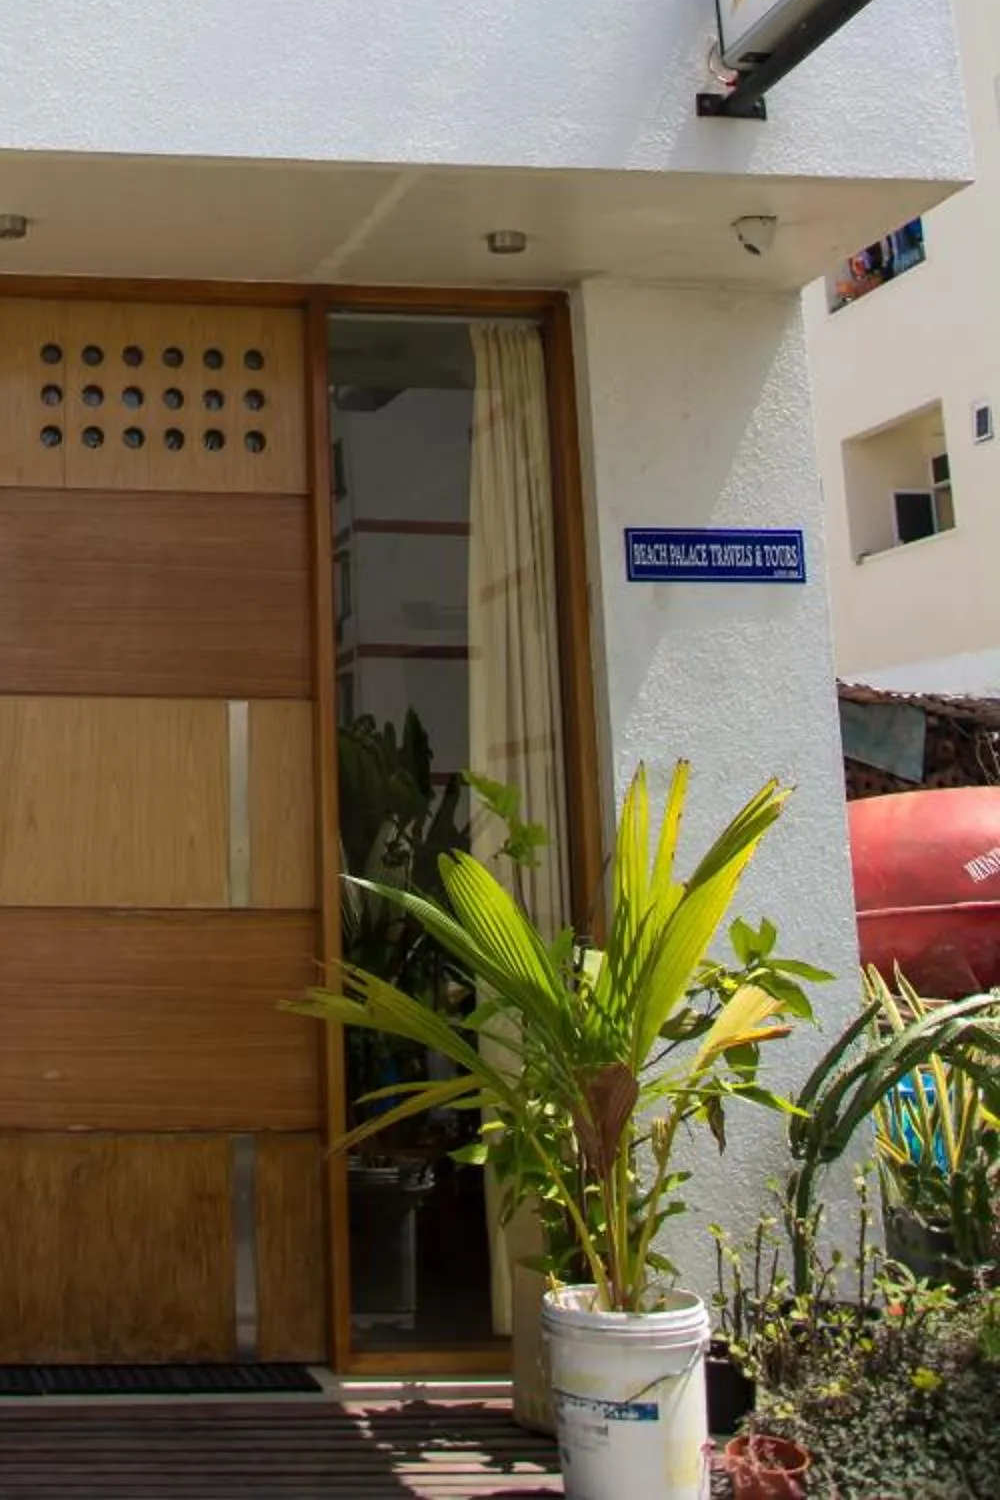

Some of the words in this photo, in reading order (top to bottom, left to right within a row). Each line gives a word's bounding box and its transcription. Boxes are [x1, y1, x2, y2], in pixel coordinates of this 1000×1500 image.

[633, 543, 668, 565] BEACH
[669, 544, 709, 567] PALACE
[709, 544, 753, 567] TRAVELS
[754, 544, 763, 567] &
[763, 545, 798, 568] TOURS
